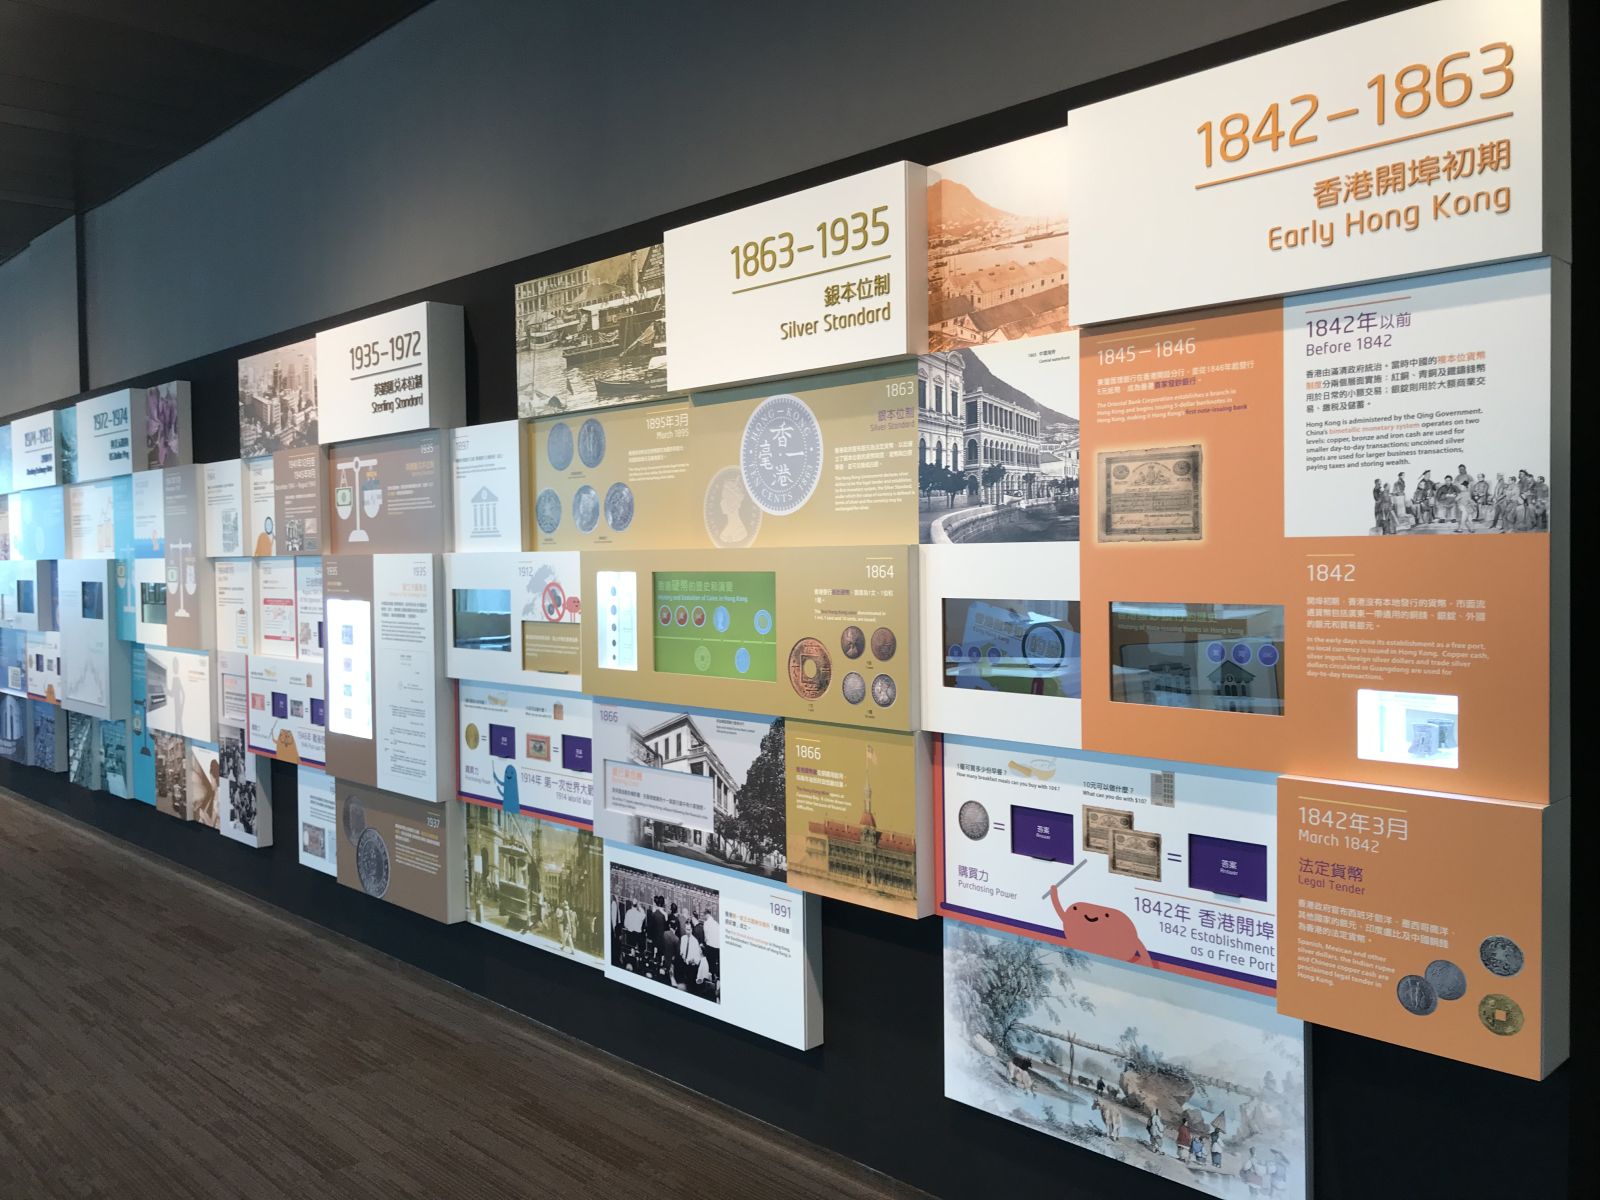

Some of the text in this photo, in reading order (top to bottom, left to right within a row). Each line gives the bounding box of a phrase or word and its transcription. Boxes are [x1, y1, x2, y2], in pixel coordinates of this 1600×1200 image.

[1314, 138, 1511, 208] 香港開埠初期
[1268, 186, 1510, 250] Early Hong Kong
[824, 274, 890, 307] 銀本位制
[781, 302, 891, 340] Silver Standard
[1306, 312, 1411, 338] 1842年以前
[1306, 334, 1392, 356] Before 1842
[886, 382, 914, 397] 1863
[372, 393, 423, 413] Sterling Standard
[1349, 415, 1392, 424] administered
[1421, 420, 1452, 428] operates
[1330, 444, 1365, 452] day-to-day
[866, 565, 894, 578] 1864
[1306, 564, 1356, 582] 1842
[600, 710, 618, 722] 1866
[796, 744, 821, 760] 1866
[1298, 807, 1408, 841] 1842年3月
[1298, 829, 1380, 854] March 1842
[959, 864, 988, 882] 購買力
[1298, 857, 1363, 882] 法定貨幣
[958, 880, 1017, 900] Purchasing Power
[1298, 875, 1365, 895] Legal Tender
[770, 902, 791, 919] 1891
[1134, 897, 1274, 940] 1842年 香港開埠
[1160, 922, 1275, 957] 1842 Establishment
[1190, 946, 1275, 973] as a Free Port
